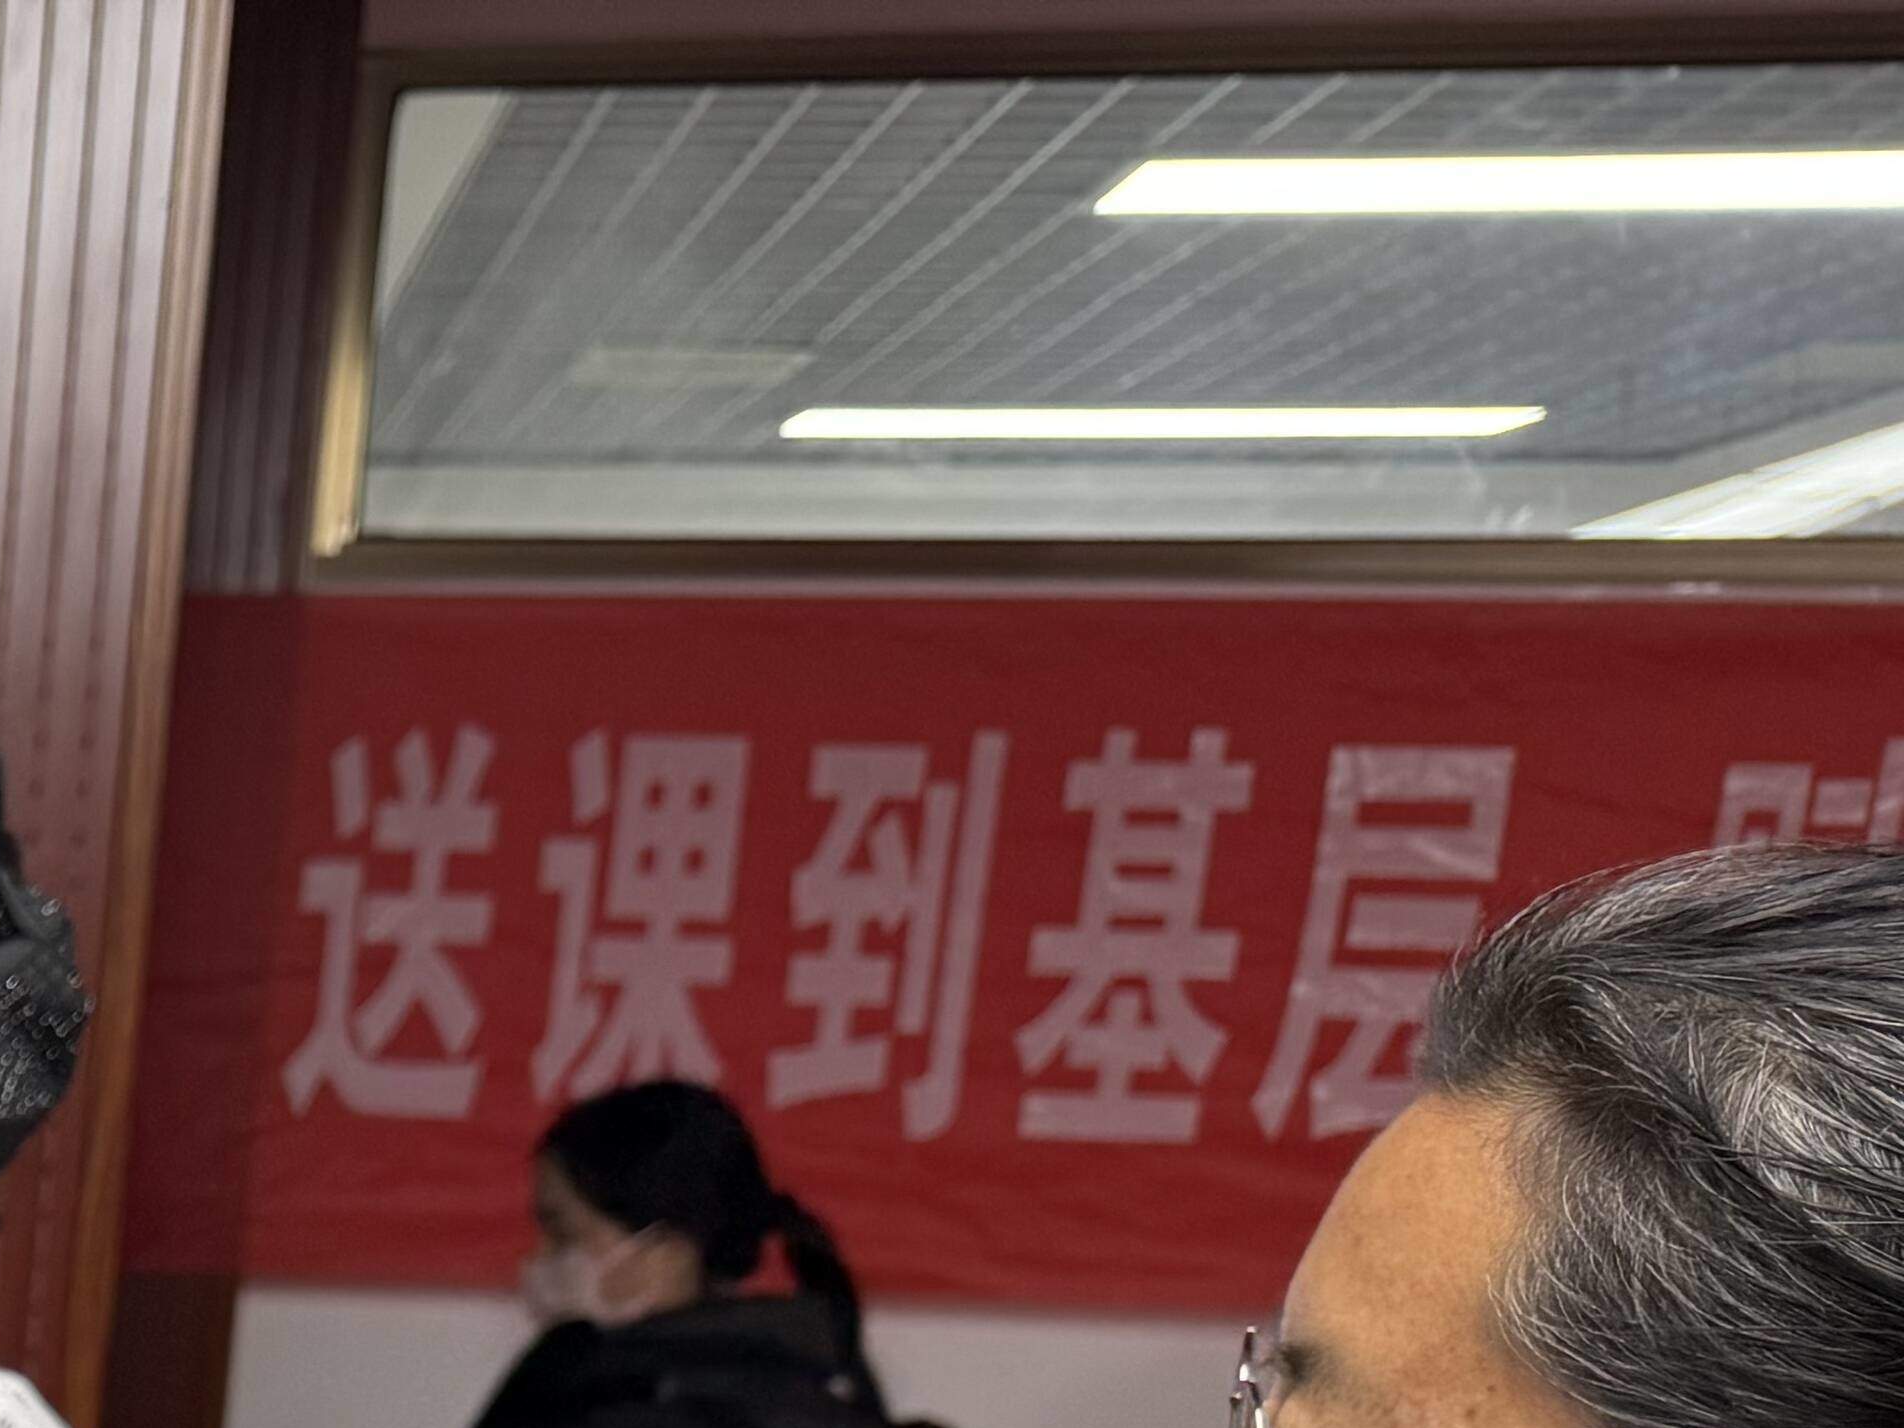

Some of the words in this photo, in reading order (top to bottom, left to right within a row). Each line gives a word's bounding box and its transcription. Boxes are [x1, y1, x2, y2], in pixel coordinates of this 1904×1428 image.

[282, 722, 1516, 1143] 送课到基层
